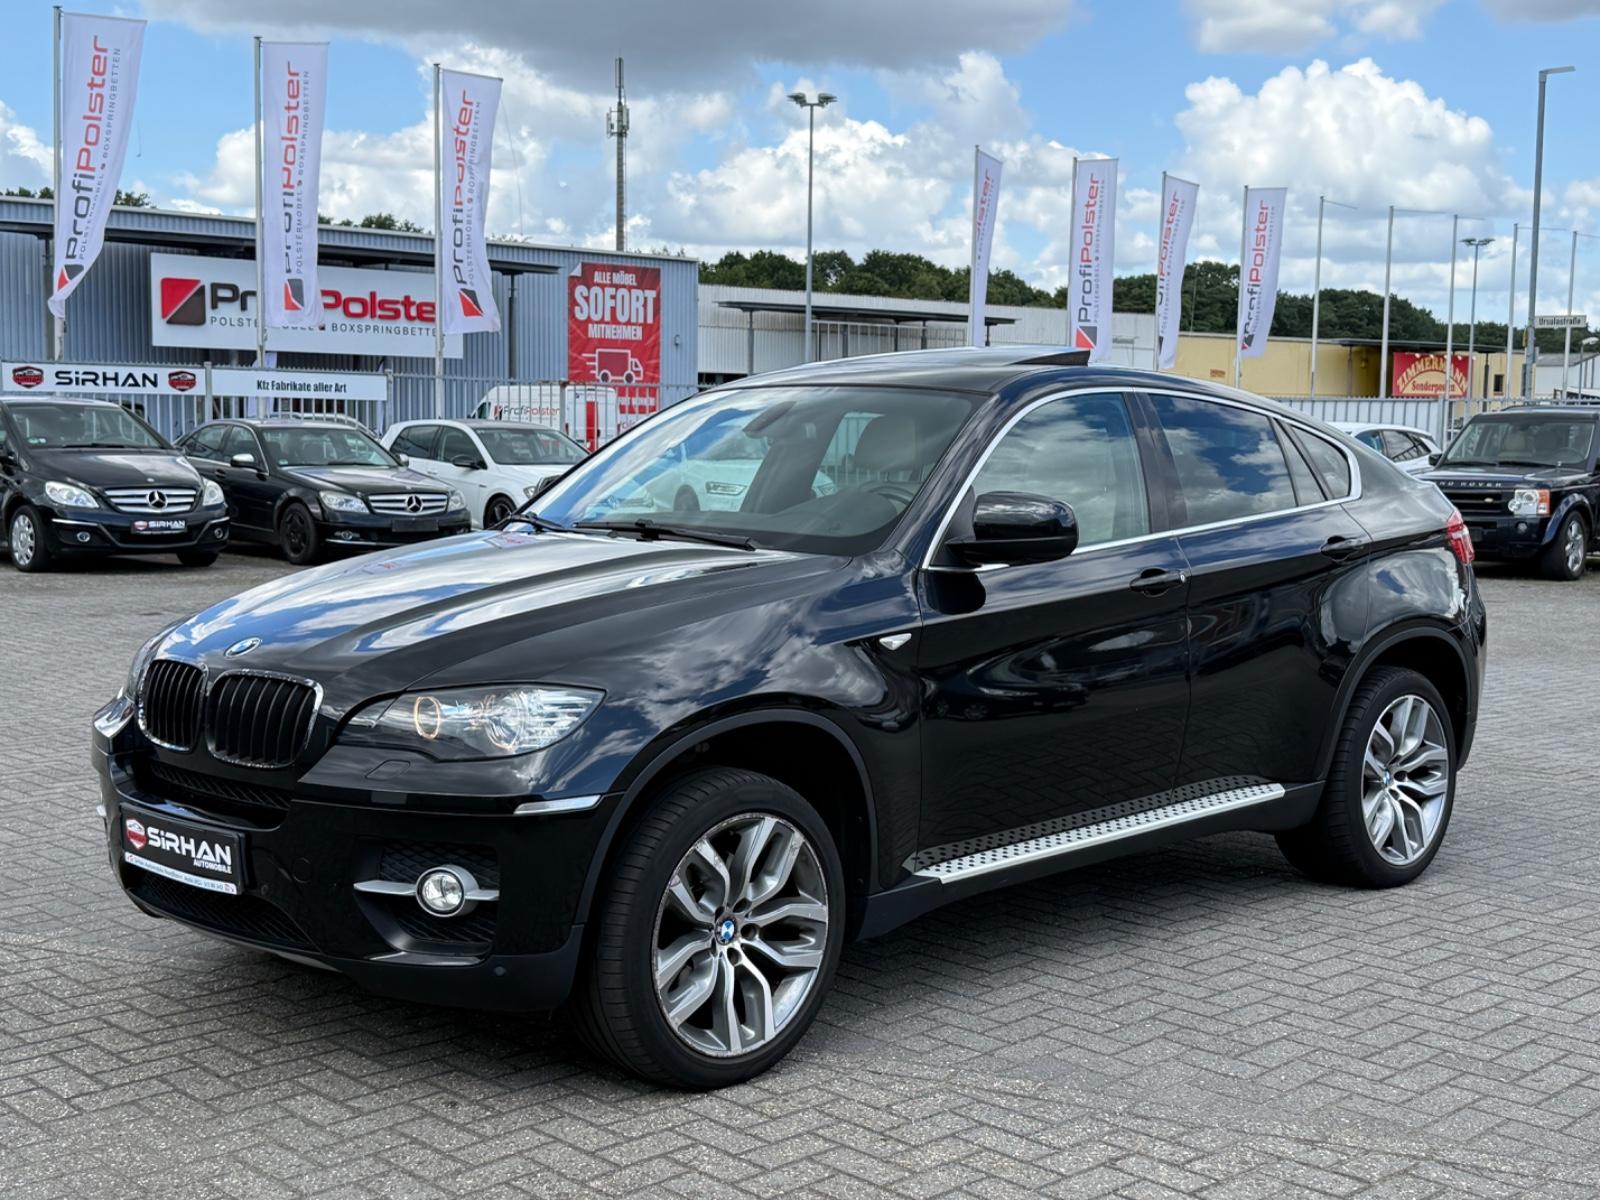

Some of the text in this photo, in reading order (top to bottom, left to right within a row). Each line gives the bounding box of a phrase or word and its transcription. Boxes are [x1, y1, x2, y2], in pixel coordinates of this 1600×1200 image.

[65, 34, 108, 259] ProfiPolster
[1078, 172, 1099, 323] ProfiPolster
[593, 271, 638, 287] ALLE MÖBEL
[574, 285, 657, 324] SOFORT
[331, 322, 437, 337] BOXSPRINGBETTE
[588, 324, 643, 341] MITNEHMEN
[1396, 356, 1468, 393] ZIMMERMNN
[271, 380, 311, 392] Fabrikate
[313, 382, 333, 393] aller
[335, 382, 347, 393] Art
[193, 858, 232, 874] AUTOMOBILE
